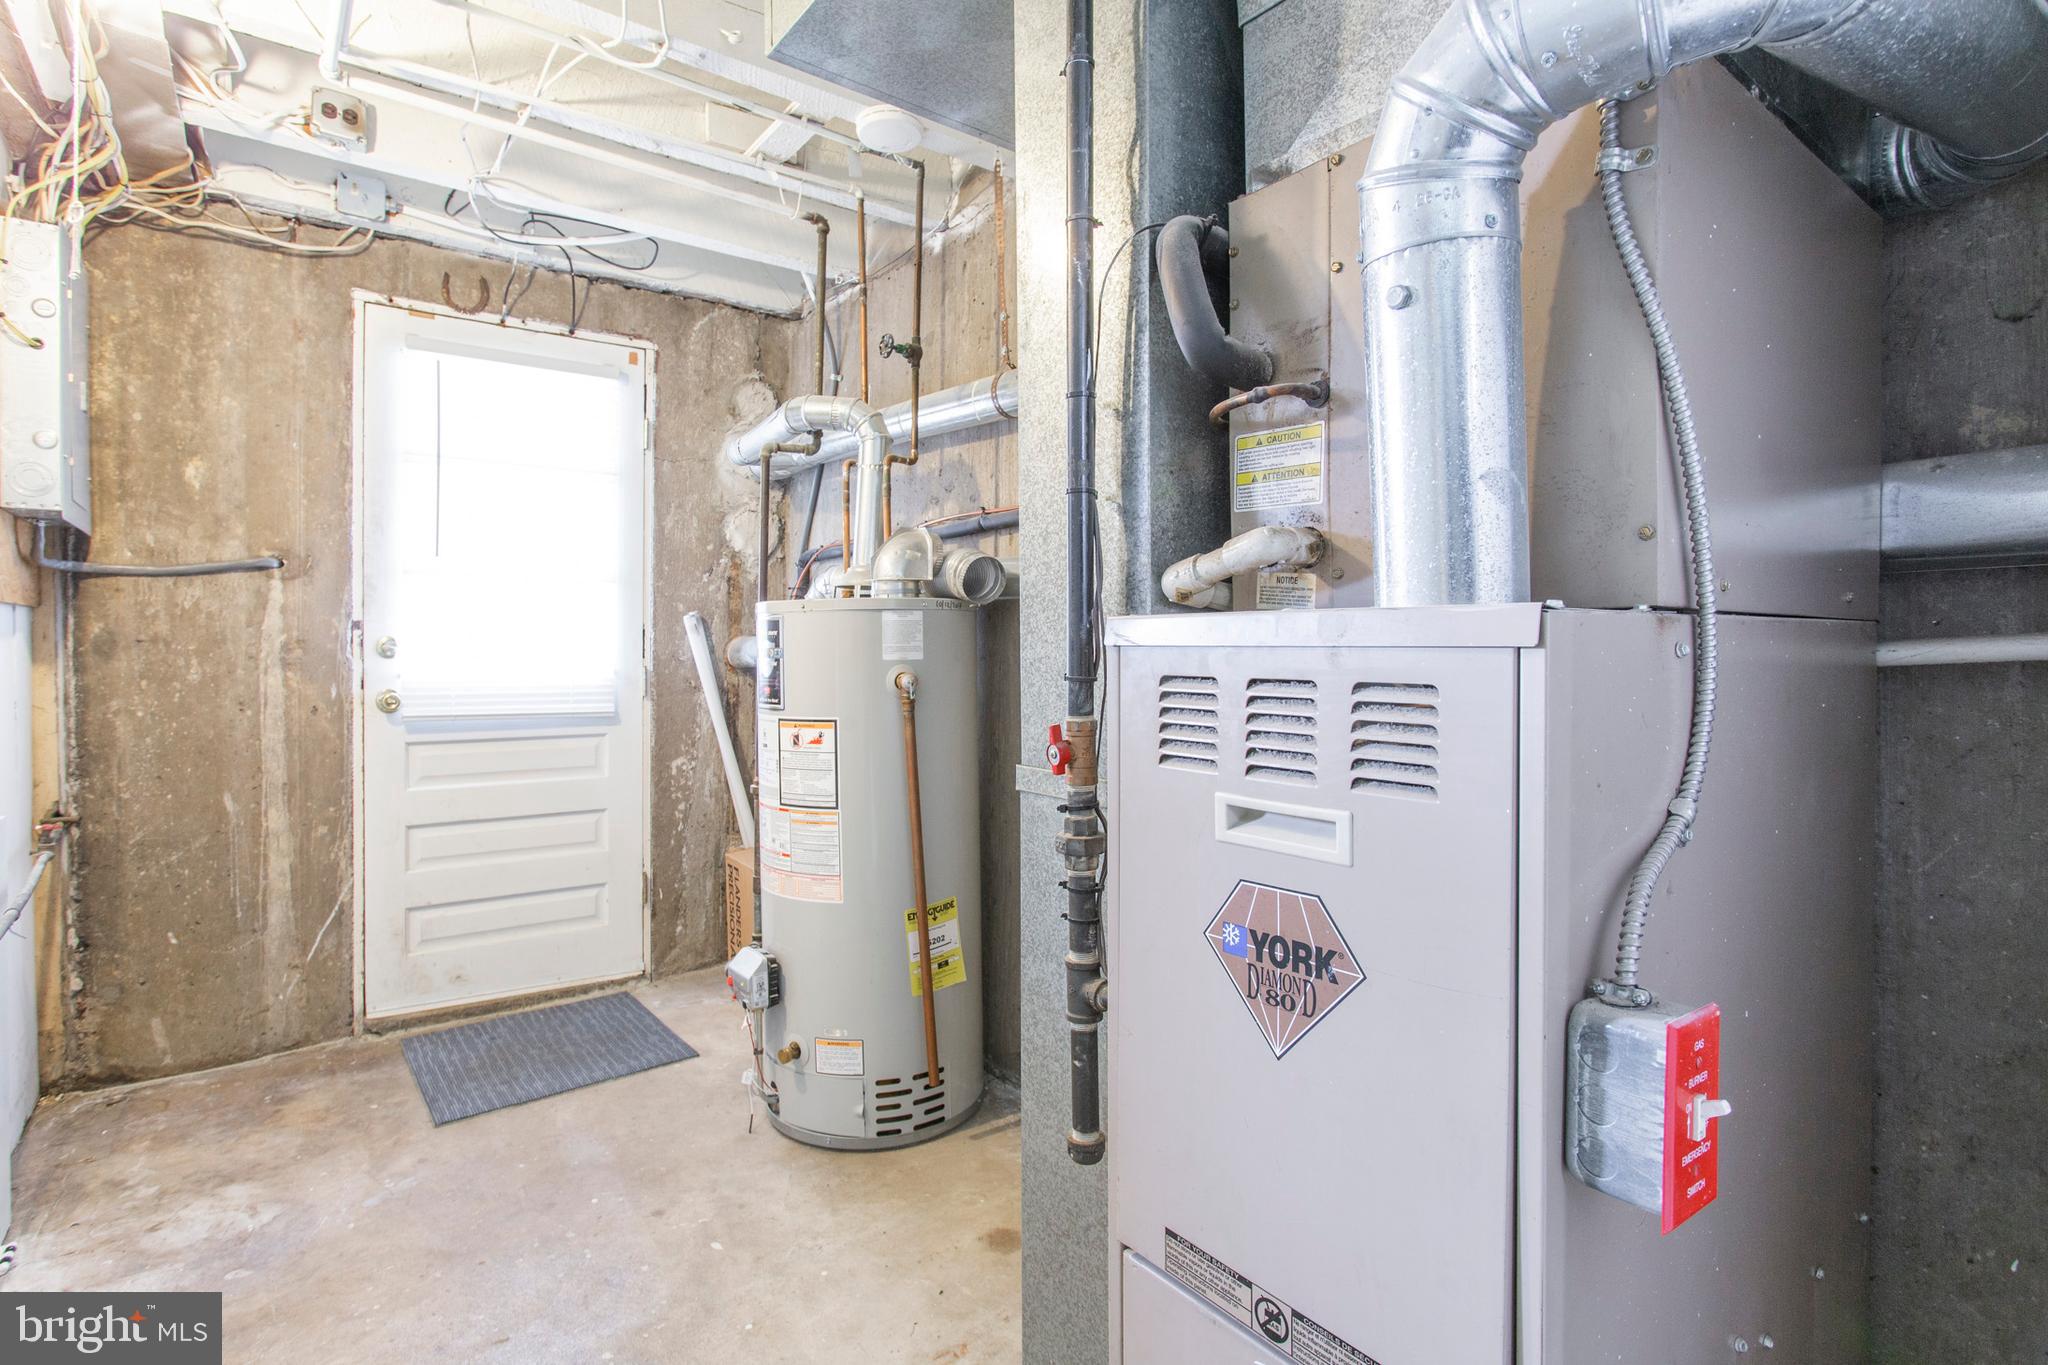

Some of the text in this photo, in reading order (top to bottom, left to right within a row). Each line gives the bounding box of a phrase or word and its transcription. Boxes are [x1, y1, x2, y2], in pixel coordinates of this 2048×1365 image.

[1266, 431, 1302, 445] CAUTION
[1261, 467, 1305, 482] ATTENTION
[1276, 575, 1299, 585] NOTICE
[727, 863, 737, 958] PRECISIONA
[733, 864, 743, 948] FLANDERS
[1249, 928, 1339, 985] YORK
[1247, 963, 1317, 1018] DIAMOND
[1266, 989, 1296, 1012] 80
[1694, 1038, 1705, 1052] GAS
[1688, 1071, 1708, 1089] BURNER
[1681, 1140, 1712, 1168] EMERGENCY
[1686, 1178, 1706, 1198] SWITCH
[1177, 1235, 1238, 1280] FOR YOUR SAFETY
[1303, 1316, 1340, 1346] CONSEILS
[1341, 1341, 1352, 1354] DE
